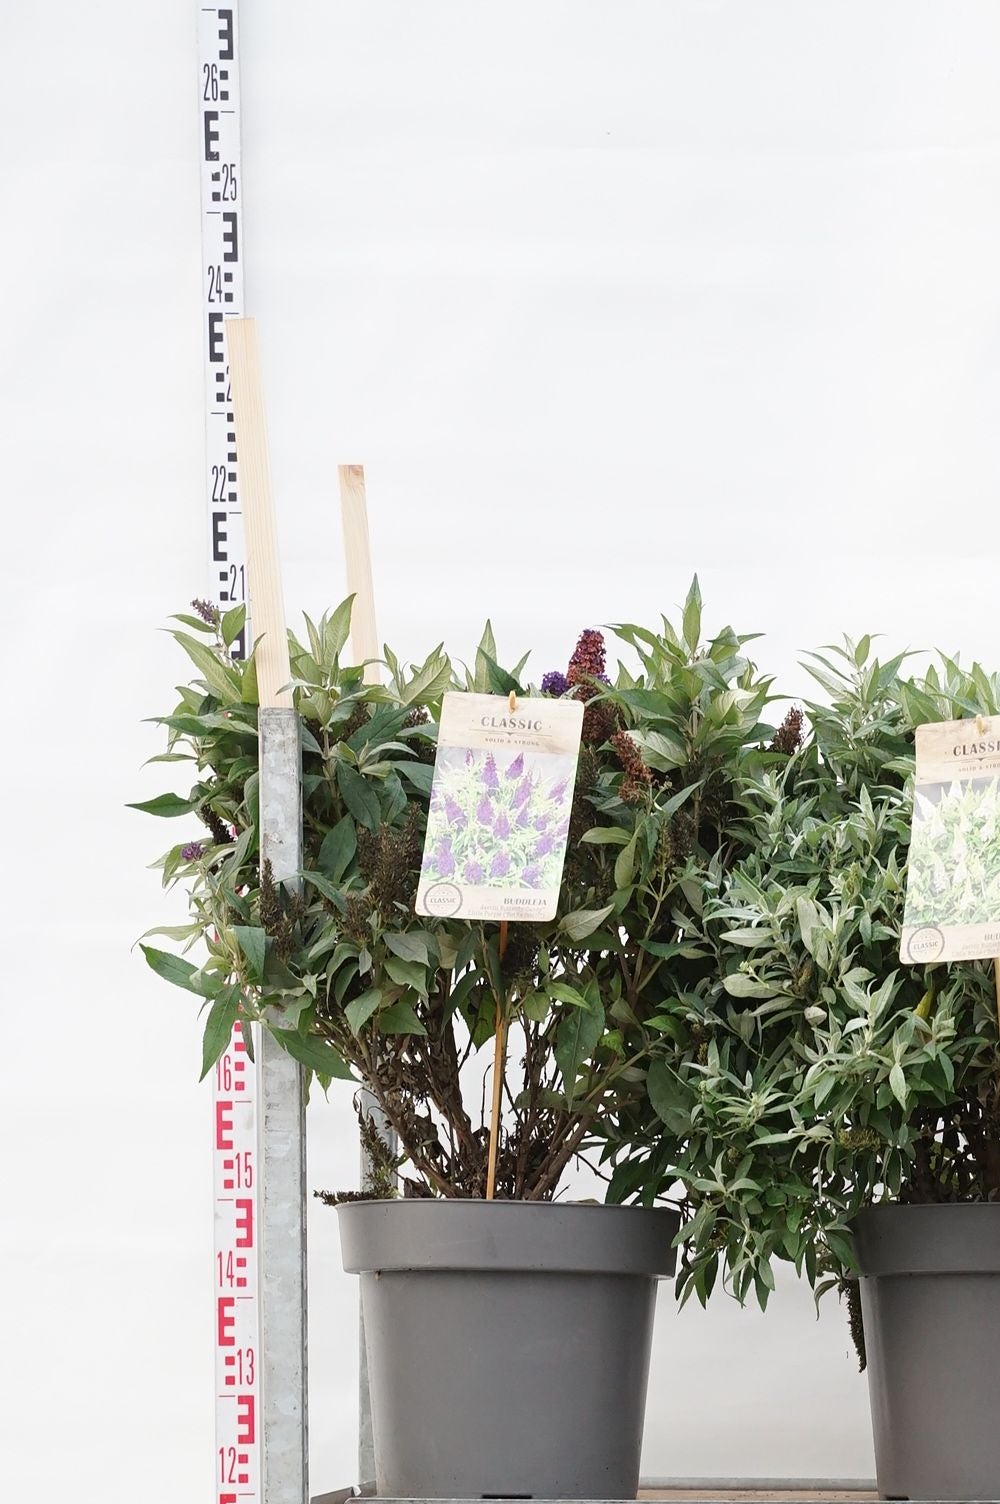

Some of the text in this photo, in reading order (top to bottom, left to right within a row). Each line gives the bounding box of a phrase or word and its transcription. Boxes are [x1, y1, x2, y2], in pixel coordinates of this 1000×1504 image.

[203, 63, 218, 102] 26
[222, 163, 237, 202] 25
[208, 265, 222, 304] 24
[212, 465, 227, 502] 22
[230, 564, 245, 601] 21
[481, 716, 543, 732] CLASSIC
[504, 897, 547, 906] BUDDLEJA
[913, 941, 938, 950] CLASSIC
[216, 1055, 232, 1092] 16
[235, 1152, 253, 1189] 15
[217, 1250, 235, 1288] 14
[237, 1348, 255, 1385] 13
[219, 1446, 237, 1484] 12
